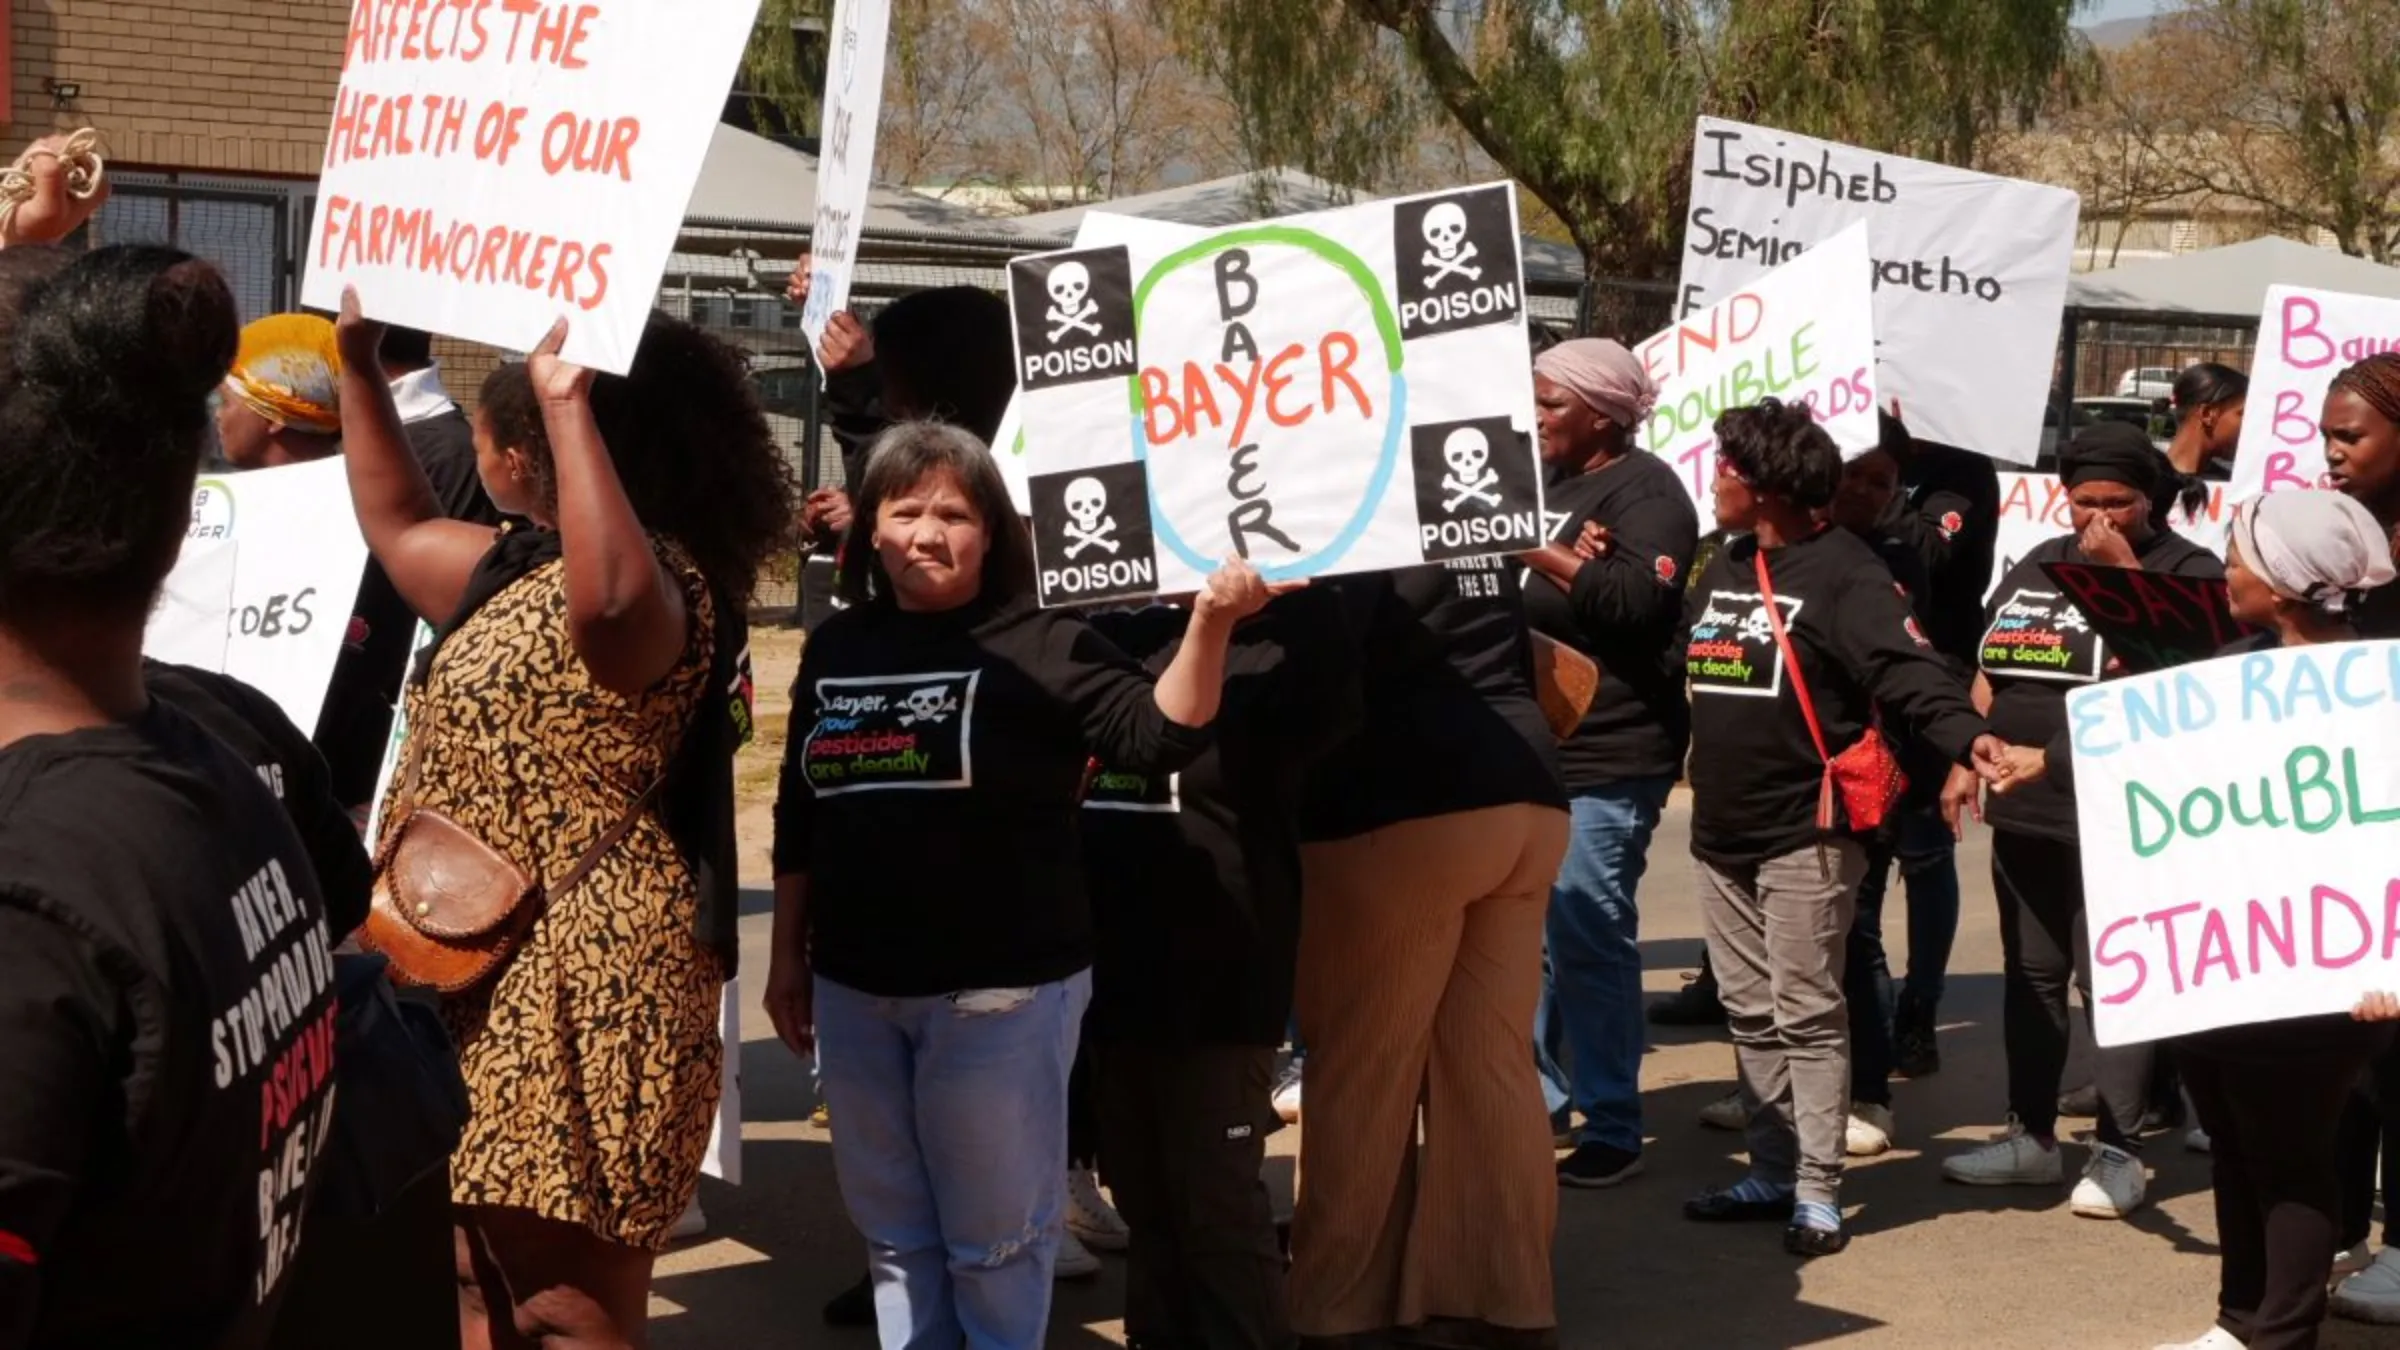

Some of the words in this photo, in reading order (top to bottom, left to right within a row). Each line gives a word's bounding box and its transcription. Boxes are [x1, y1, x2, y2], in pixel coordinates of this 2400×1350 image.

[342, 0, 491, 72] AFFECTS
[502, 0, 600, 69] THE
[474, 101, 528, 166] OF
[541, 111, 640, 181] OUR
[319, 194, 612, 310] FARMWORKERS
[1401, 282, 1517, 329] POISON
[1025, 339, 1135, 381] POISON
[1643, 292, 1763, 383] END
[1140, 331, 1373, 449] BAYER
[1647, 321, 1820, 451] DOUBLE
[1421, 512, 1536, 550] POISON
[1042, 557, 1153, 595] POISON
[1701, 657, 1753, 682] deadly
[1984, 646, 2008, 660] are
[2012, 644, 2072, 669] deadly
[2071, 671, 2217, 757] END
[809, 760, 844, 780] are
[849, 748, 931, 775] deadly
